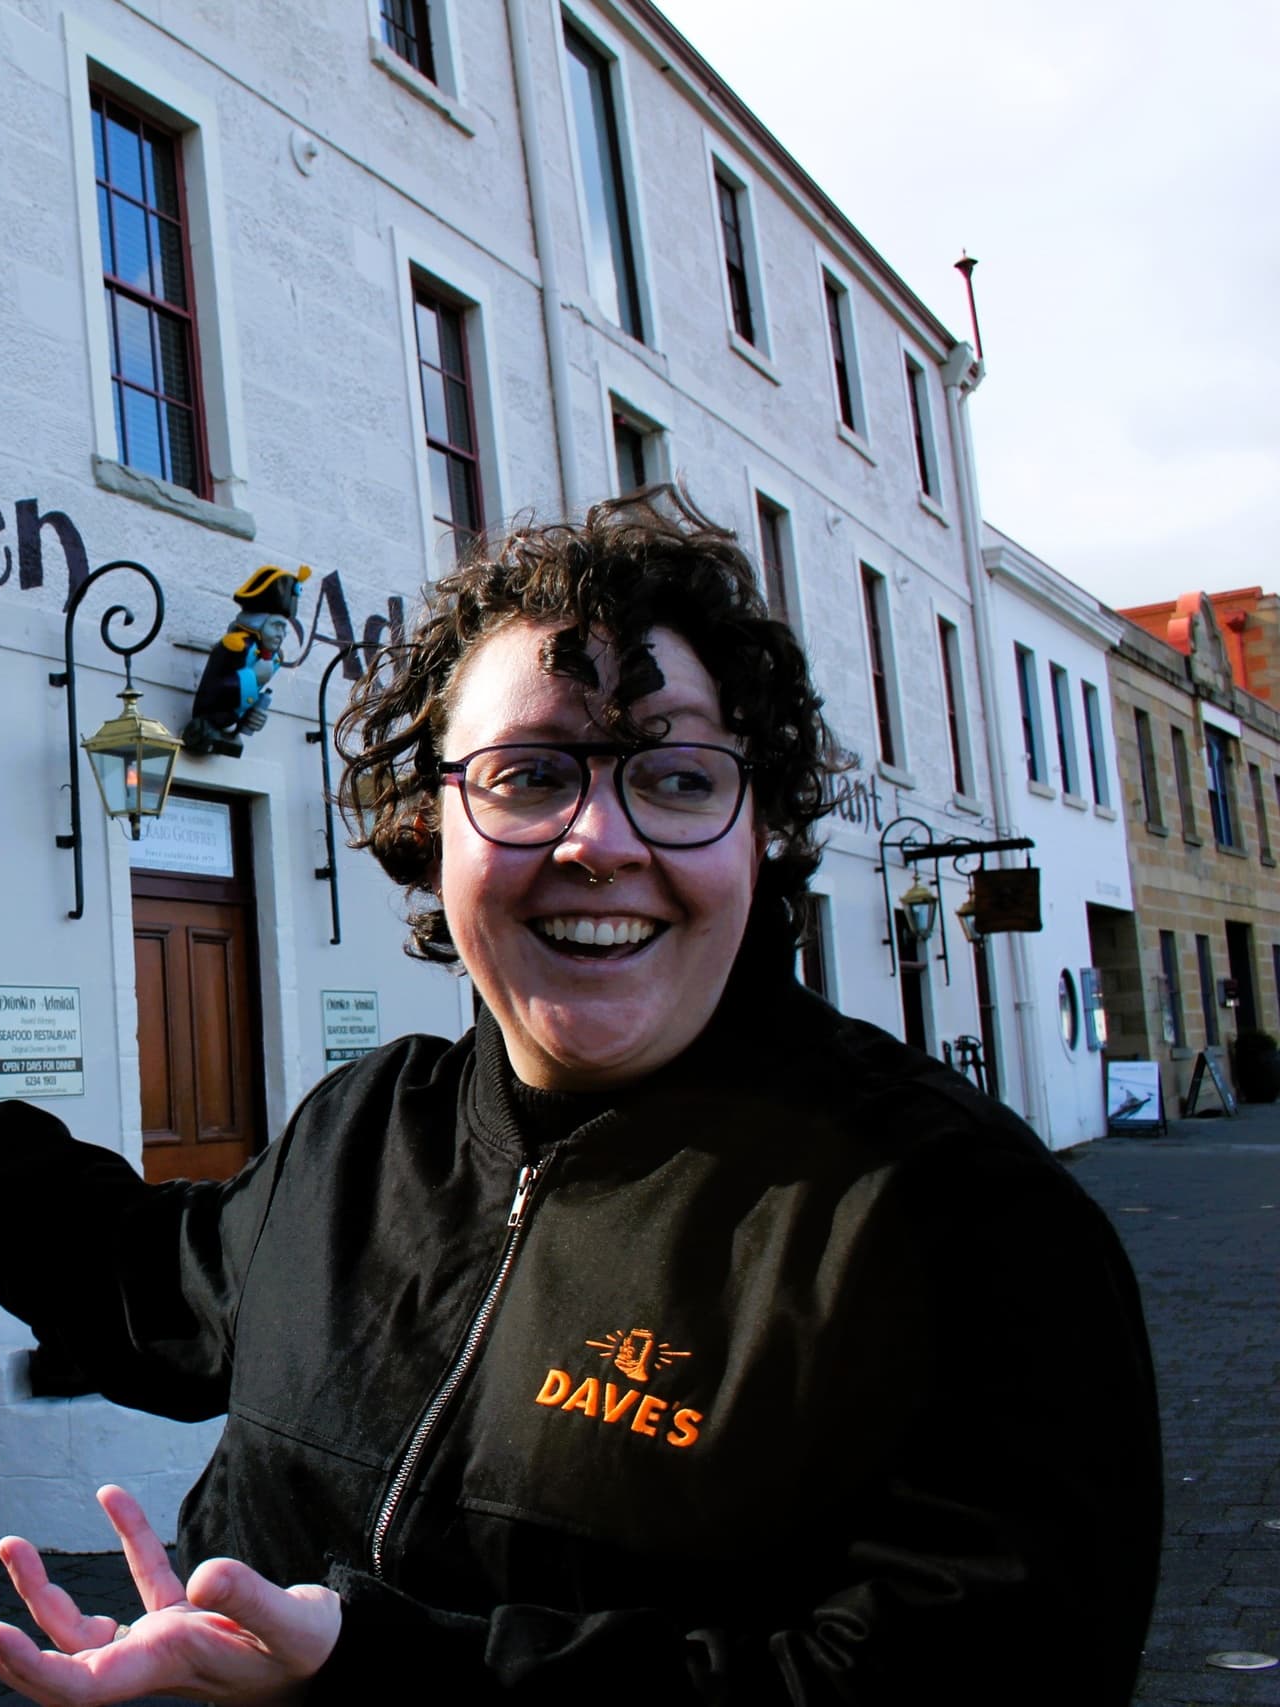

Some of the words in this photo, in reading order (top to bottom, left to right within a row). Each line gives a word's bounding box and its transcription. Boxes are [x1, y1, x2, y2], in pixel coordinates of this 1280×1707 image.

[34, 1029, 77, 1041] RESTAURANT
[2, 1061, 19, 1072] OPEN
[535, 1368, 704, 1448] DAVE'S
